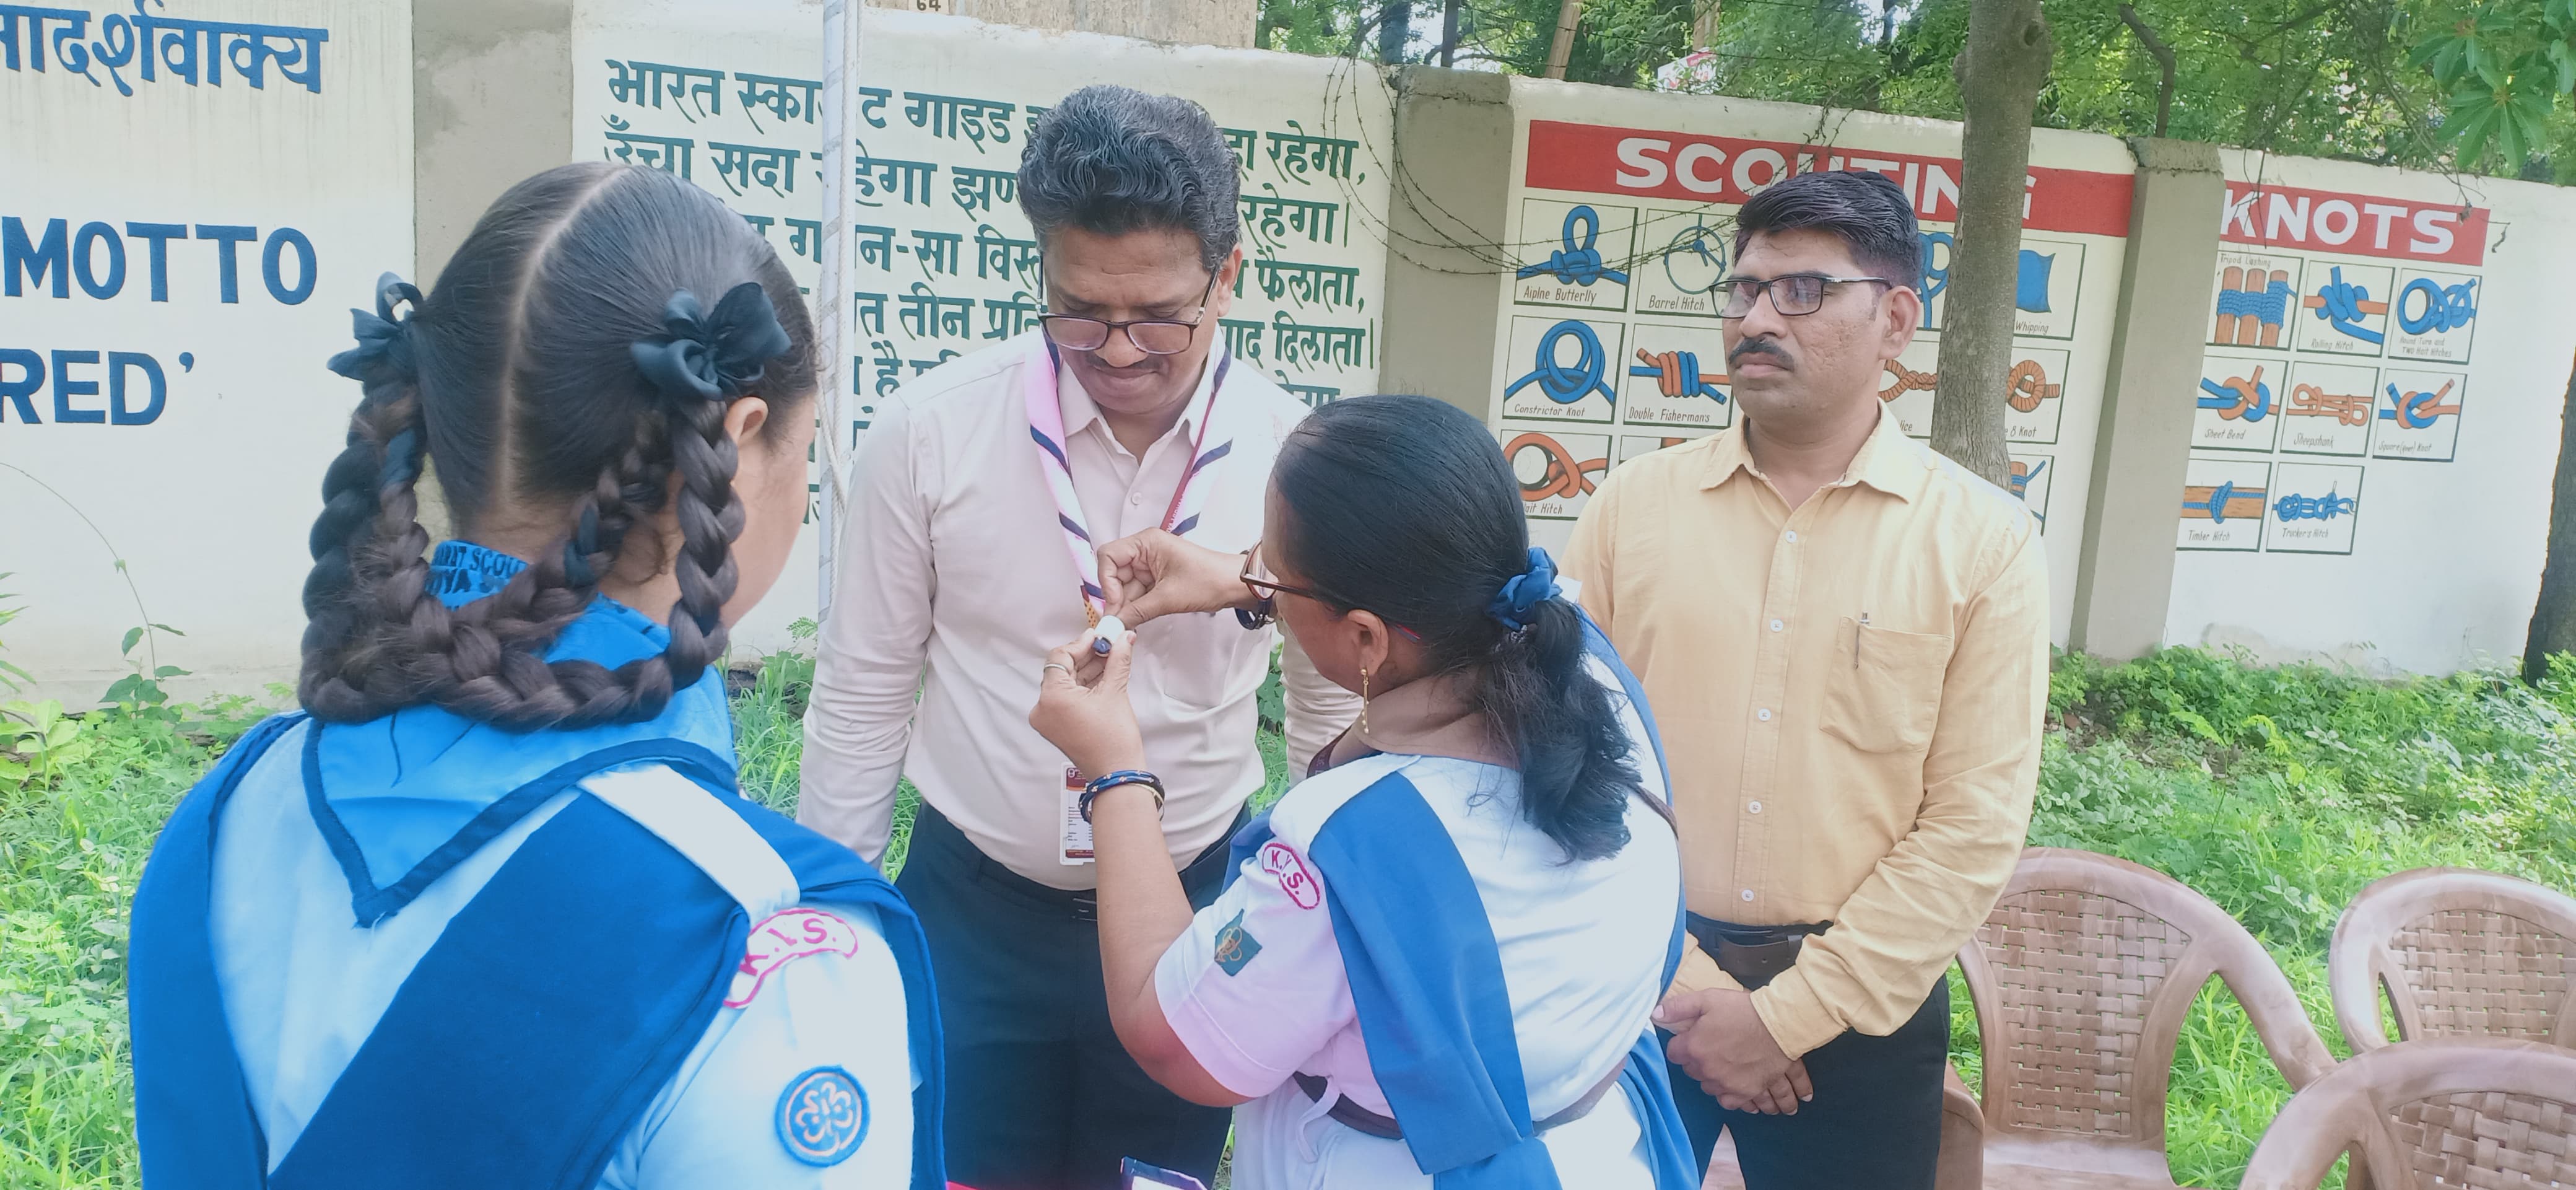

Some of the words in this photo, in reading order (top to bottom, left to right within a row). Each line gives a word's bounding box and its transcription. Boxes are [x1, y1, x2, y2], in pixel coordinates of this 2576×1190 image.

[916, 0, 942, 12] 64
[604, 59, 726, 124] भारत
[734, 72, 892, 134] स्काट
[903, 91, 1016, 154] गाइड
[707, 141, 801, 198] सदा
[2220, 188, 2458, 255] KNOTS
[1, 216, 318, 306] MOTTO
[2221, 253, 2242, 265] Tripod
[2245, 255, 2271, 269] Lashing
[1648, 294, 1680, 310] Barrel
[1681, 296, 1705, 311] Hitch
[898, 281, 976, 341] तीन
[2016, 320, 2050, 335] Whipping
[2311, 338, 2333, 351] Rolling
[2335, 341, 2354, 351] Hitch
[1515, 403, 1562, 416] Constrictor
[1566, 406, 1586, 417] Knot
[1629, 406, 1655, 421] Double
[2018, 426, 2037, 438] Knot
[2205, 428, 2226, 439] Sheet
[2227, 429, 2247, 439] Bend
[2294, 432, 2334, 448] Sheepshank
[1540, 502, 1564, 515] Hitch
[2188, 530, 2210, 541] Timber
[2213, 530, 2230, 541] Hitch
